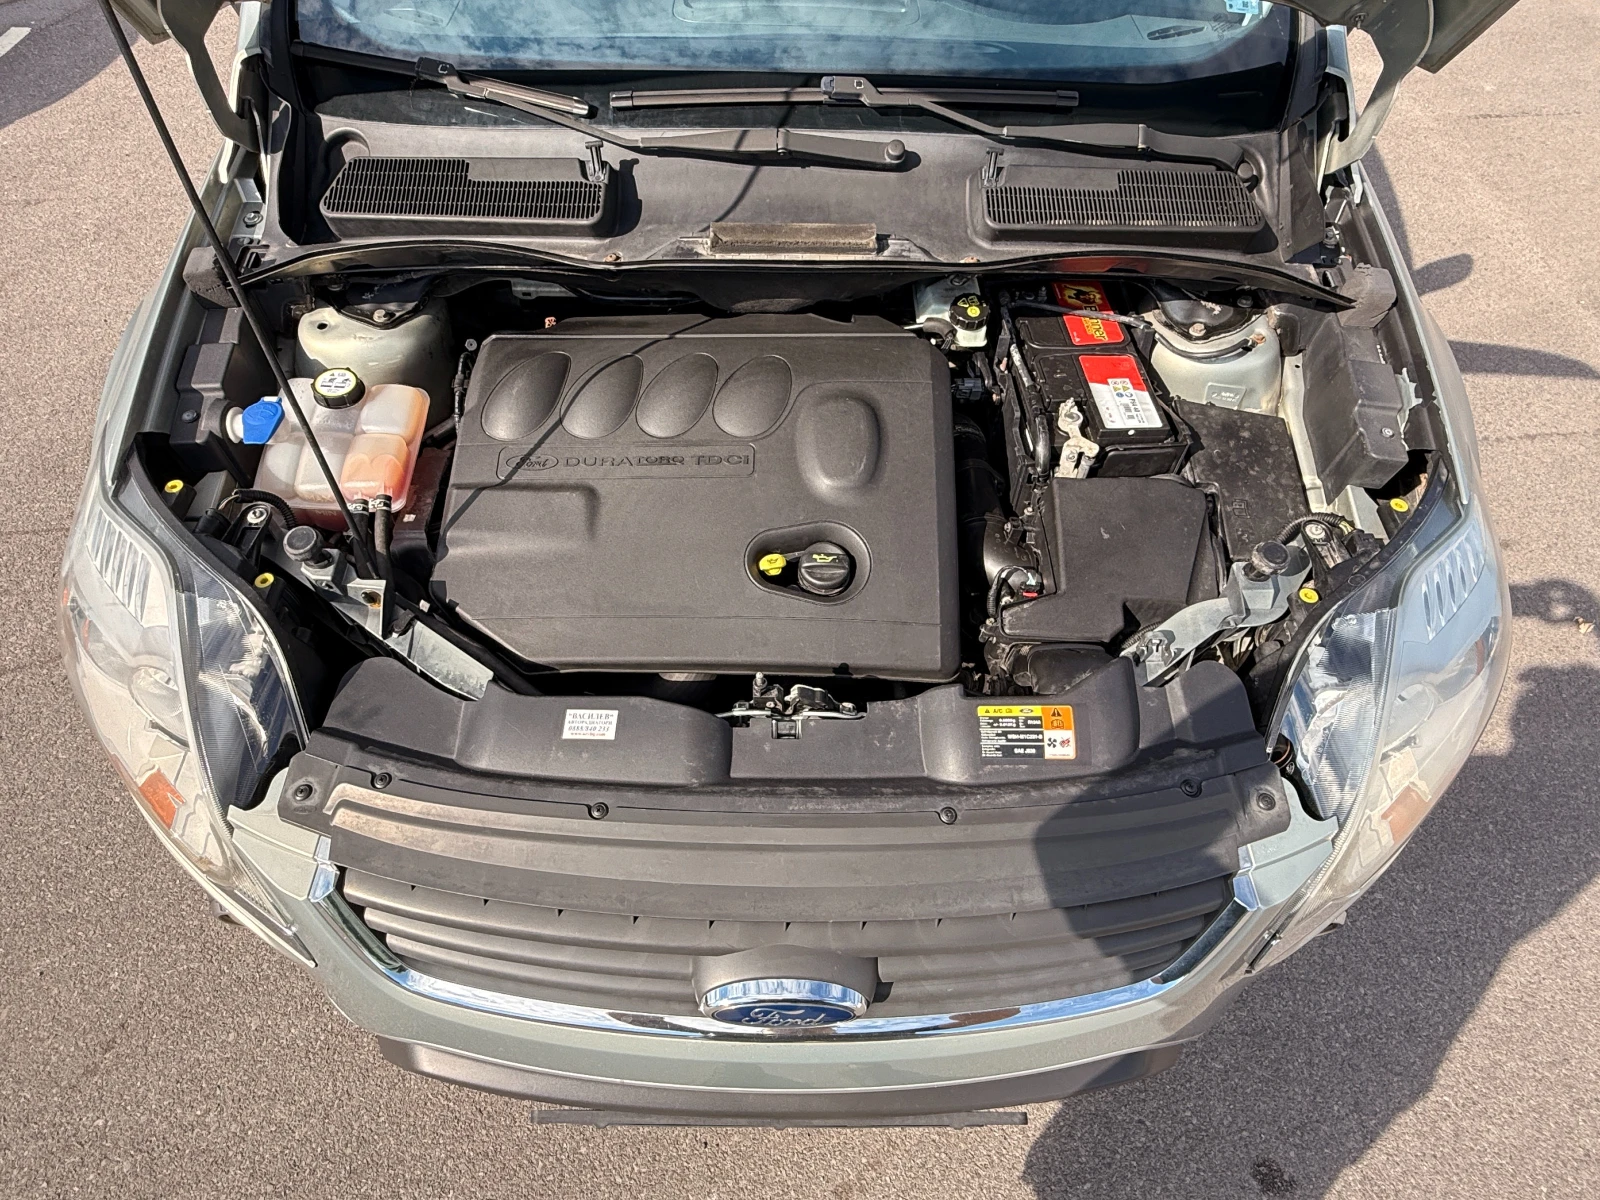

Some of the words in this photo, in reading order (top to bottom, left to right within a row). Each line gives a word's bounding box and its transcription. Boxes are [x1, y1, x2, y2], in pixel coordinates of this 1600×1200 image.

[516, 455, 550, 468] Ford
[563, 454, 685, 468] DURATORQ
[742, 1008, 827, 1027] Ford
